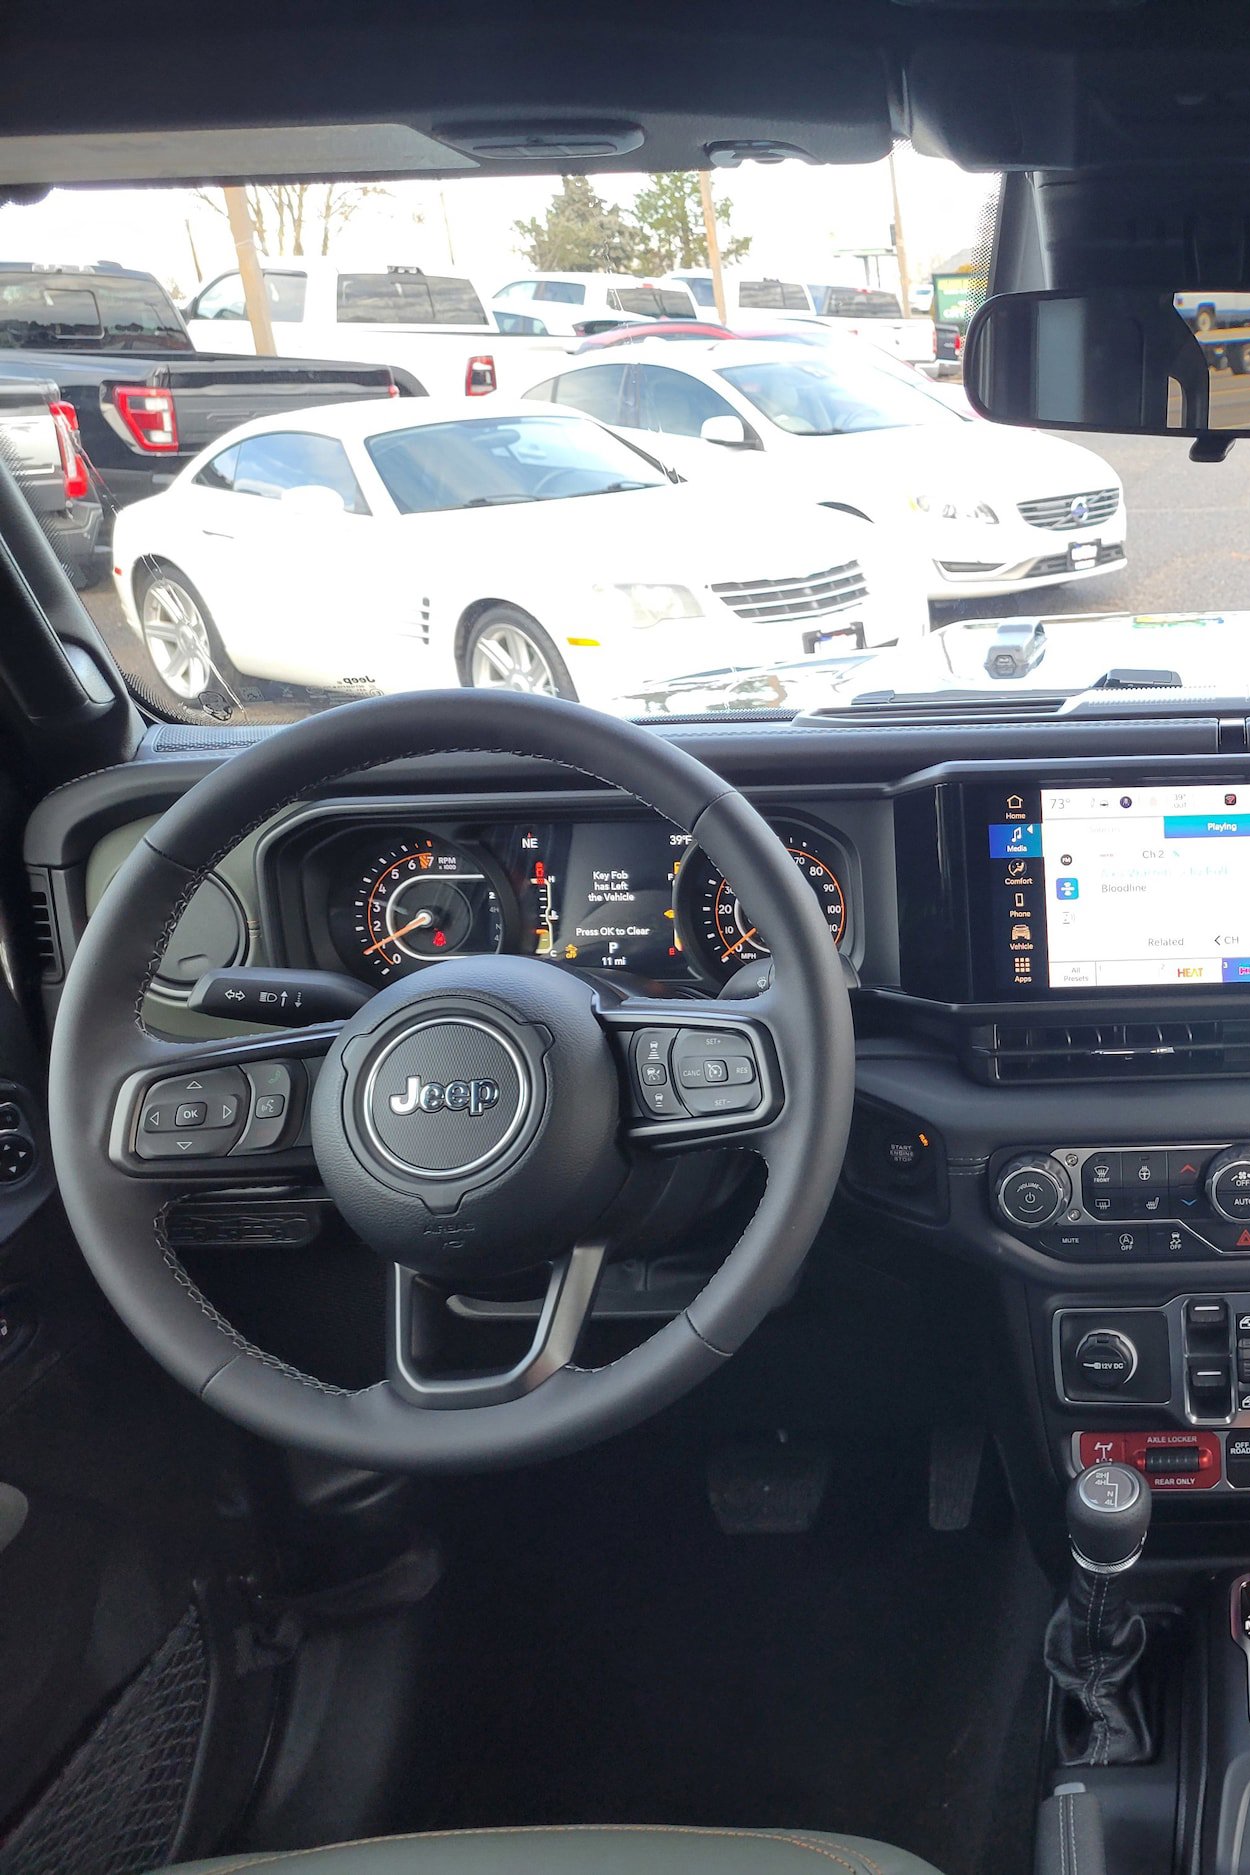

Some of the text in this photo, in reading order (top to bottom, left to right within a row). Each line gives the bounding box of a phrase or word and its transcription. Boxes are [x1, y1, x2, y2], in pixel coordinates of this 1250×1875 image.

[1050, 798, 1071, 810] 73°
[1006, 812, 1026, 820] Home
[1207, 822, 1238, 832] Playing
[522, 838, 538, 848] NE
[669, 835, 693, 846] 39°F
[1006, 845, 1028, 853] Media
[1142, 850, 1164, 859] Ch 2
[427, 857, 434, 867] 7
[794, 856, 805, 865] 70
[408, 861, 416, 870] 6
[391, 869, 399, 880] 5
[810, 866, 824, 876] 80
[593, 870, 629, 882] Key Fob
[1004, 877, 1033, 885] Comfort
[378, 884, 386, 894] 4
[594, 881, 628, 891] has Left
[823, 884, 834, 892] 90
[1101, 883, 1147, 894] Bloodline
[588, 892, 635, 902] the Vehicle
[373, 902, 381, 912] 3
[718, 905, 732, 914] 20
[827, 906, 841, 914] 100
[1010, 910, 1031, 918] Phone
[374, 921, 382, 932] 2
[576, 926, 650, 936] Press OK to Clear
[724, 926, 734, 934] 10
[830, 924, 838, 932] 10
[1148, 937, 1184, 947] Related
[1224, 936, 1240, 944] CH
[608, 942, 618, 954] P
[736, 943, 742, 952] 0
[1010, 942, 1034, 951] Vehicle
[668, 948, 675, 956] E
[740, 952, 756, 960] MPH
[392, 954, 401, 964] 0
[602, 957, 626, 966] 11 mi
[1176, 967, 1204, 978] HEAT
[1014, 976, 1032, 984] Apps
[1064, 974, 1089, 983] Presets
[389, 1074, 500, 1116] Jeep
[184, 1110, 198, 1119] OK
[1020, 1182, 1040, 1190] VOLUME
[1102, 1362, 1124, 1370] 12V DC
[1147, 1436, 1166, 1444] AXLE
[1154, 1478, 1175, 1486] REAR
